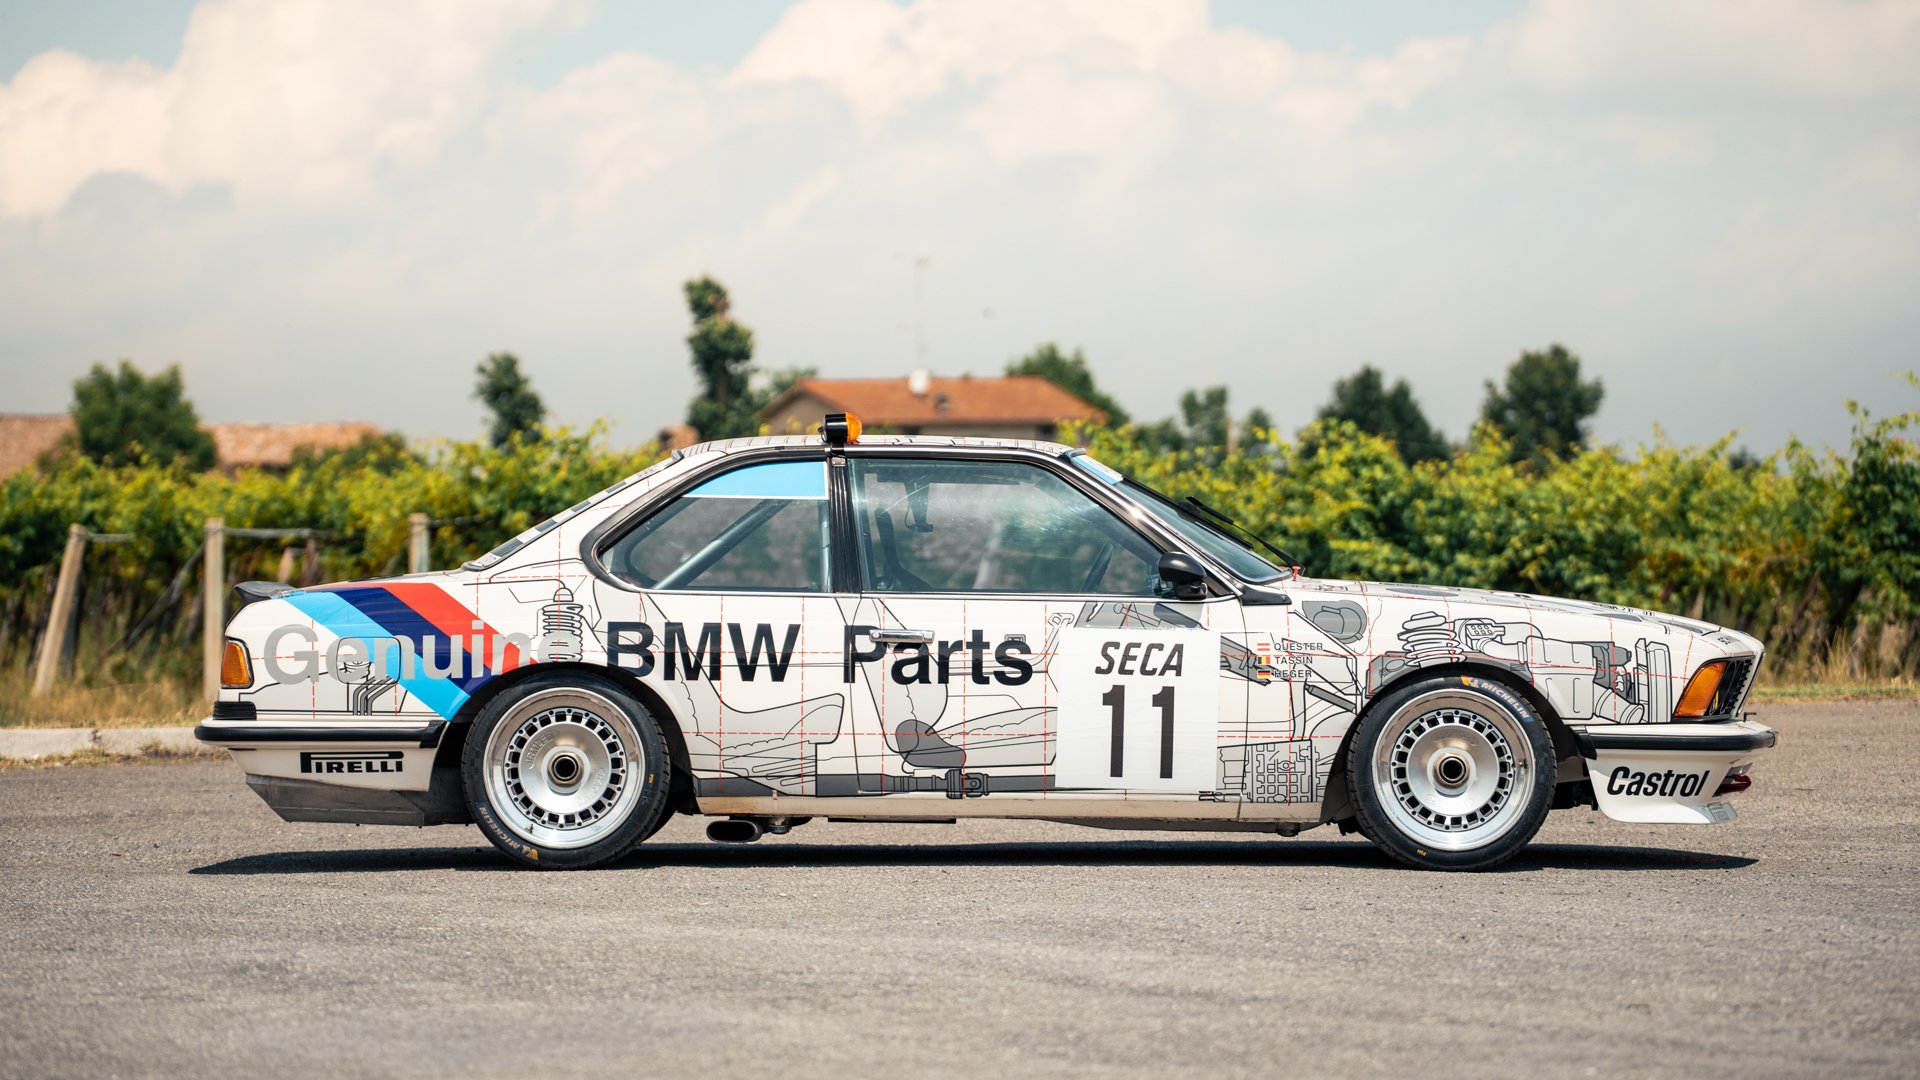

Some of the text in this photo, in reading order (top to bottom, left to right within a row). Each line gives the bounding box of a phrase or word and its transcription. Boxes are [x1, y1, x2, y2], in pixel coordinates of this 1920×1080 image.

[263, 619, 1034, 686] Genuine BMW Parts
[1094, 641, 1184, 677] SECA
[1274, 642, 1323, 652] QUESTER
[1275, 656, 1313, 665] TASSIN
[1274, 669, 1312, 679] HEGER
[1481, 682, 1530, 719] MICHELIN
[1102, 684, 1175, 779] 11
[300, 751, 404, 773] PIRELLI
[1607, 766, 1710, 797] Castrol
[479, 807, 520, 849] MICHELIN
